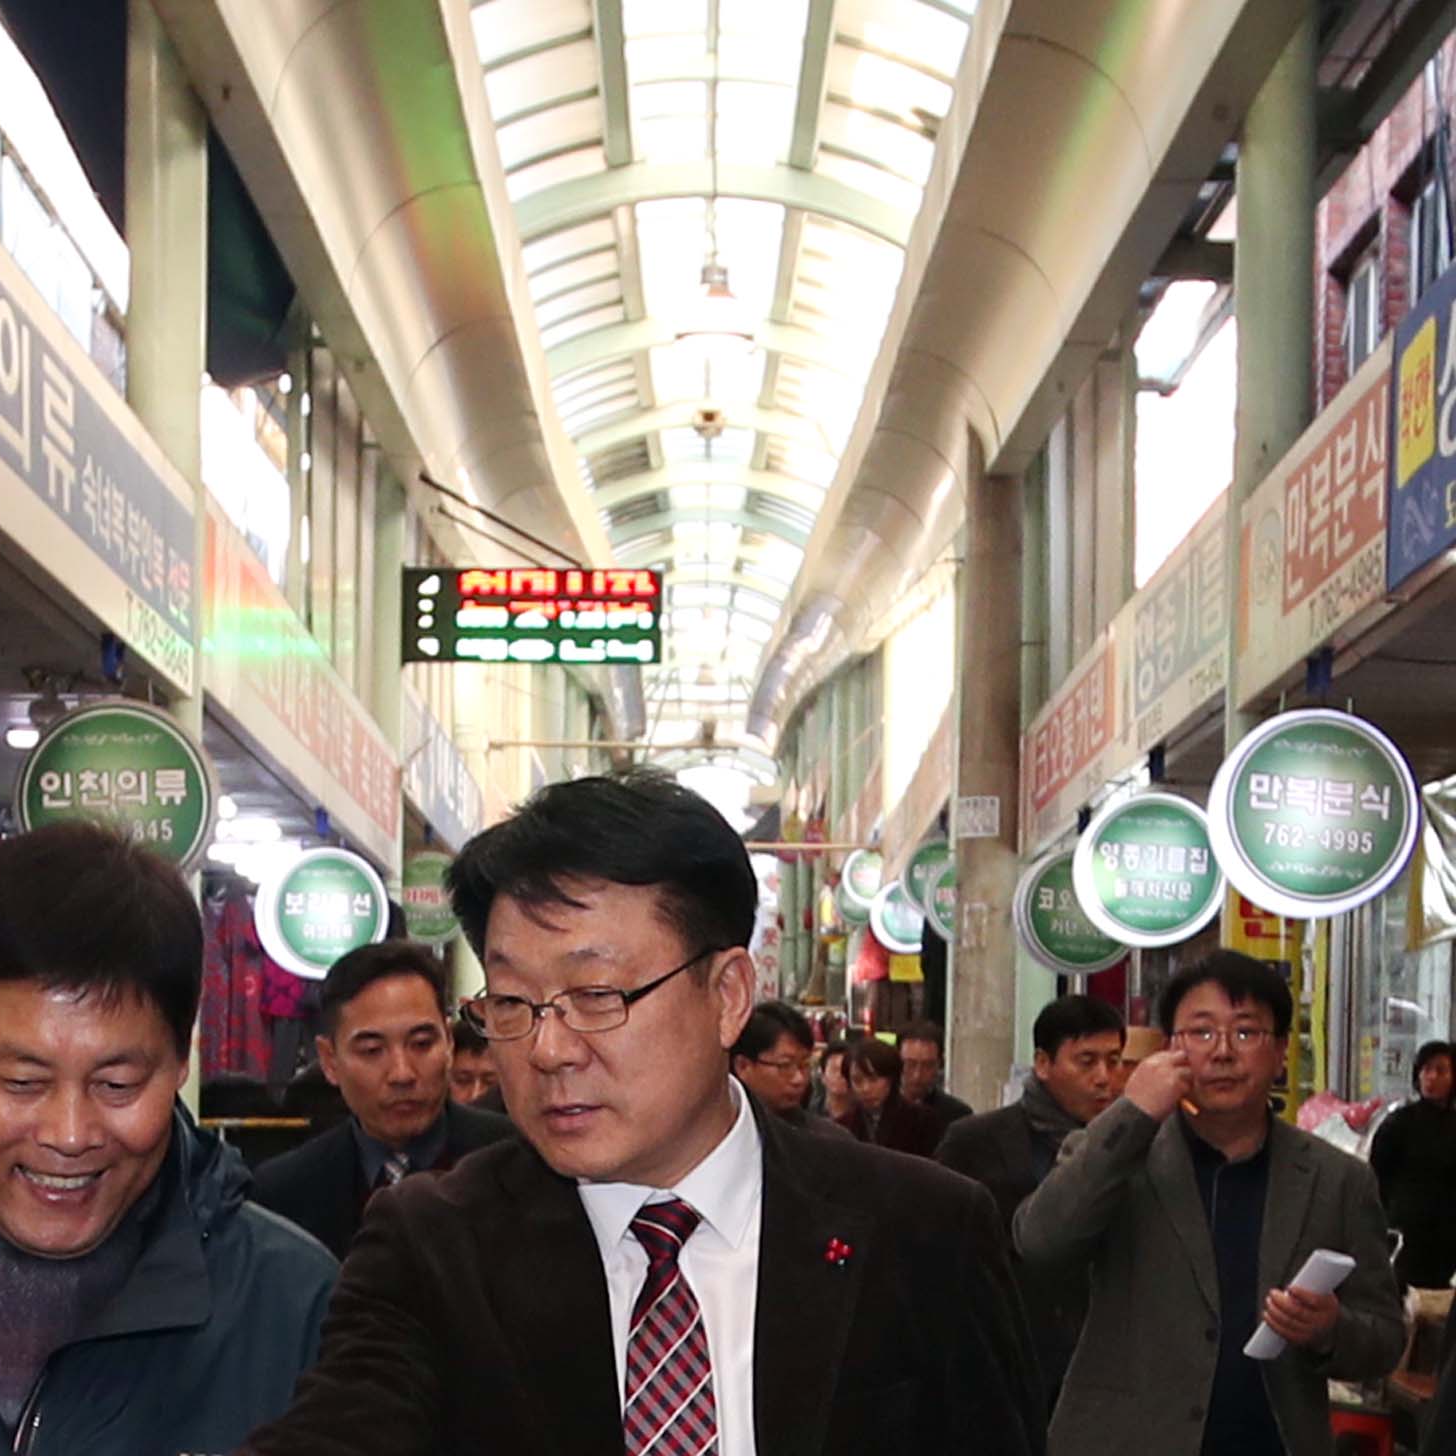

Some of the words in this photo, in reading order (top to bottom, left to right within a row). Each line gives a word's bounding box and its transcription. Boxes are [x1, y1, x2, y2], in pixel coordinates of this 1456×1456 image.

[1285, 383, 1388, 601] 만복분식
[39, 768, 187, 809] 인천의류
[1249, 773, 1391, 821] 만복분식
[1263, 822, 1374, 855] 762-4995
